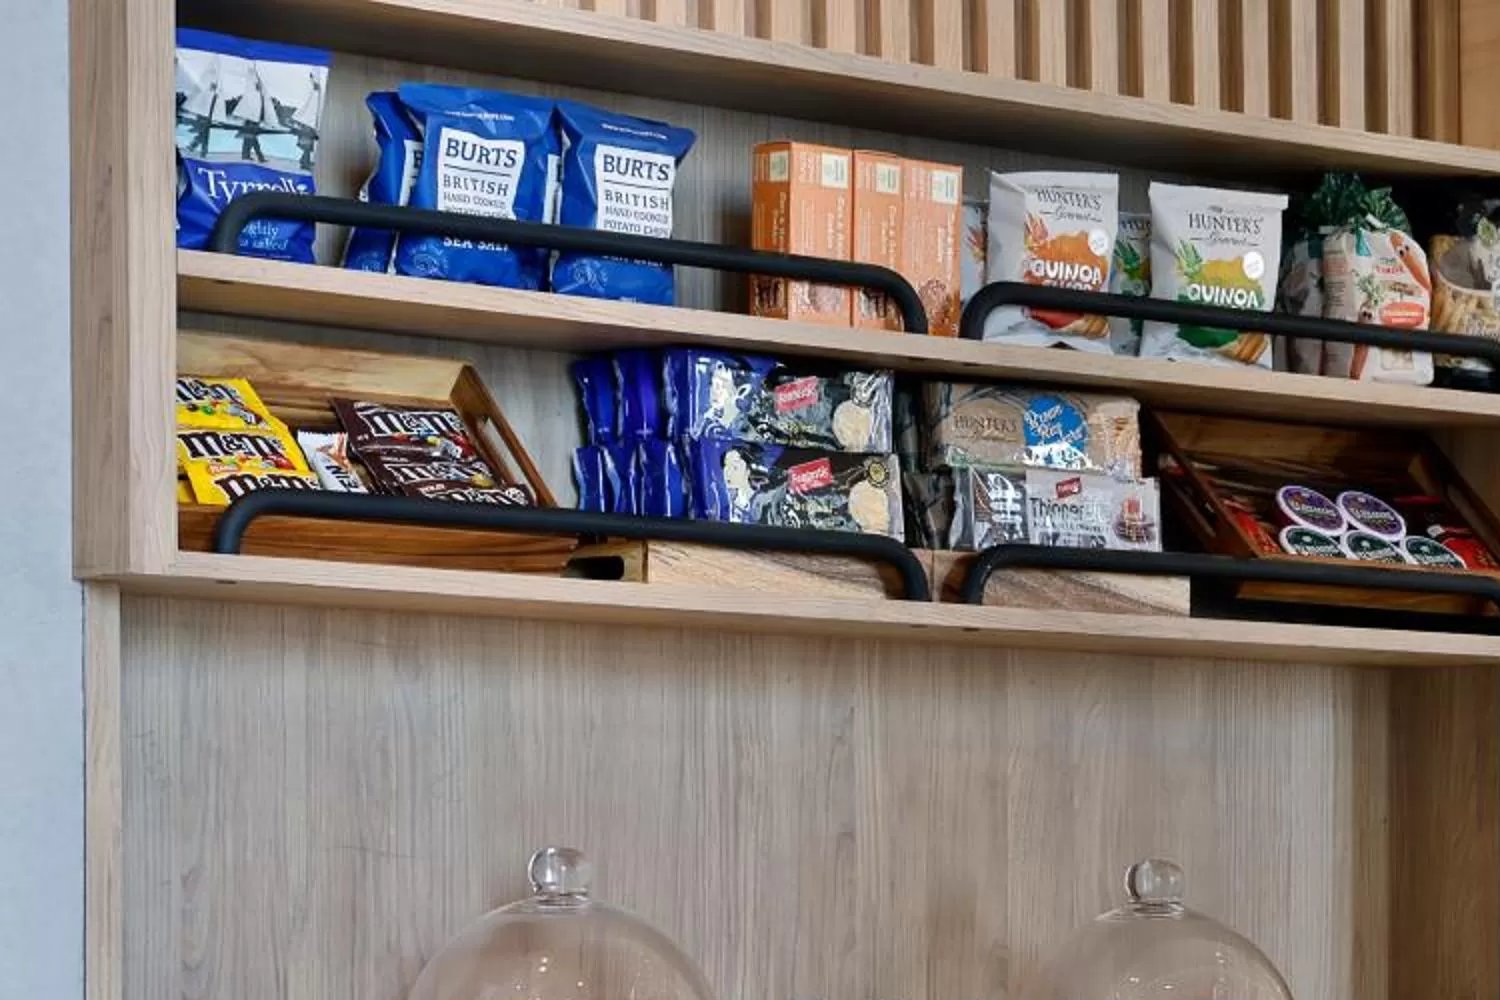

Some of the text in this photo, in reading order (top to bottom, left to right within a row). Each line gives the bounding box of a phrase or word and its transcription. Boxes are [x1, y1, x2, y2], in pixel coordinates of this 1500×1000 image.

[444, 137, 517, 169] BURTS
[603, 154, 671, 182] BURTS
[443, 174, 510, 197] BRITISH
[604, 189, 670, 211] BRITISH
[1031, 258, 1103, 285] QUINOA
[1187, 283, 1259, 309] QUINOA
